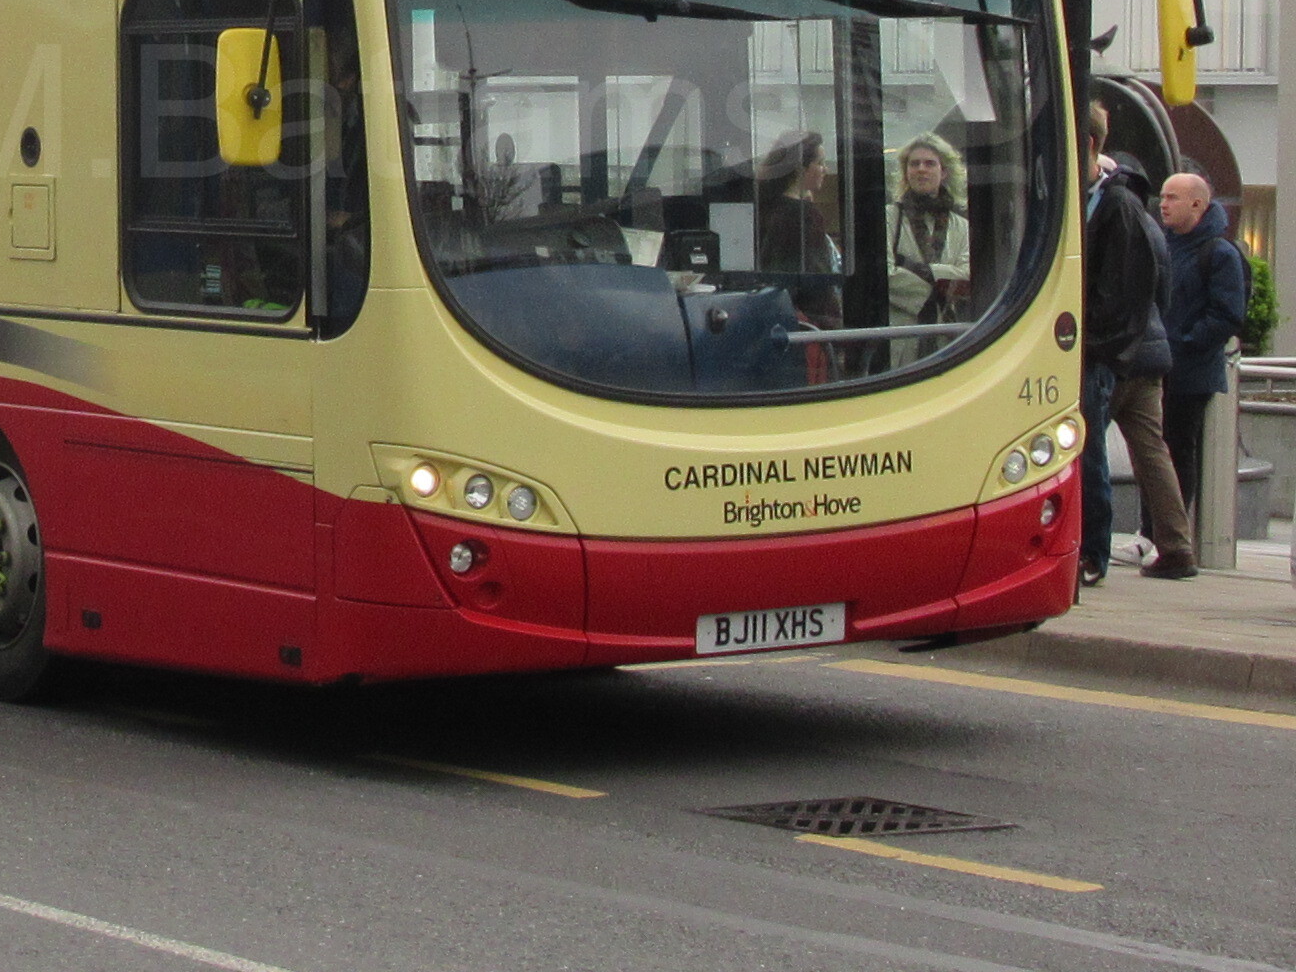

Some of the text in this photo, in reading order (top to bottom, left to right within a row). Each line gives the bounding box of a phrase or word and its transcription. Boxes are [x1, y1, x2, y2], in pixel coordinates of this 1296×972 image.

[1018, 375, 1060, 406] 416
[664, 449, 913, 491] CARDINAL NEWMAN
[714, 608, 824, 647] BJ11 XHS
